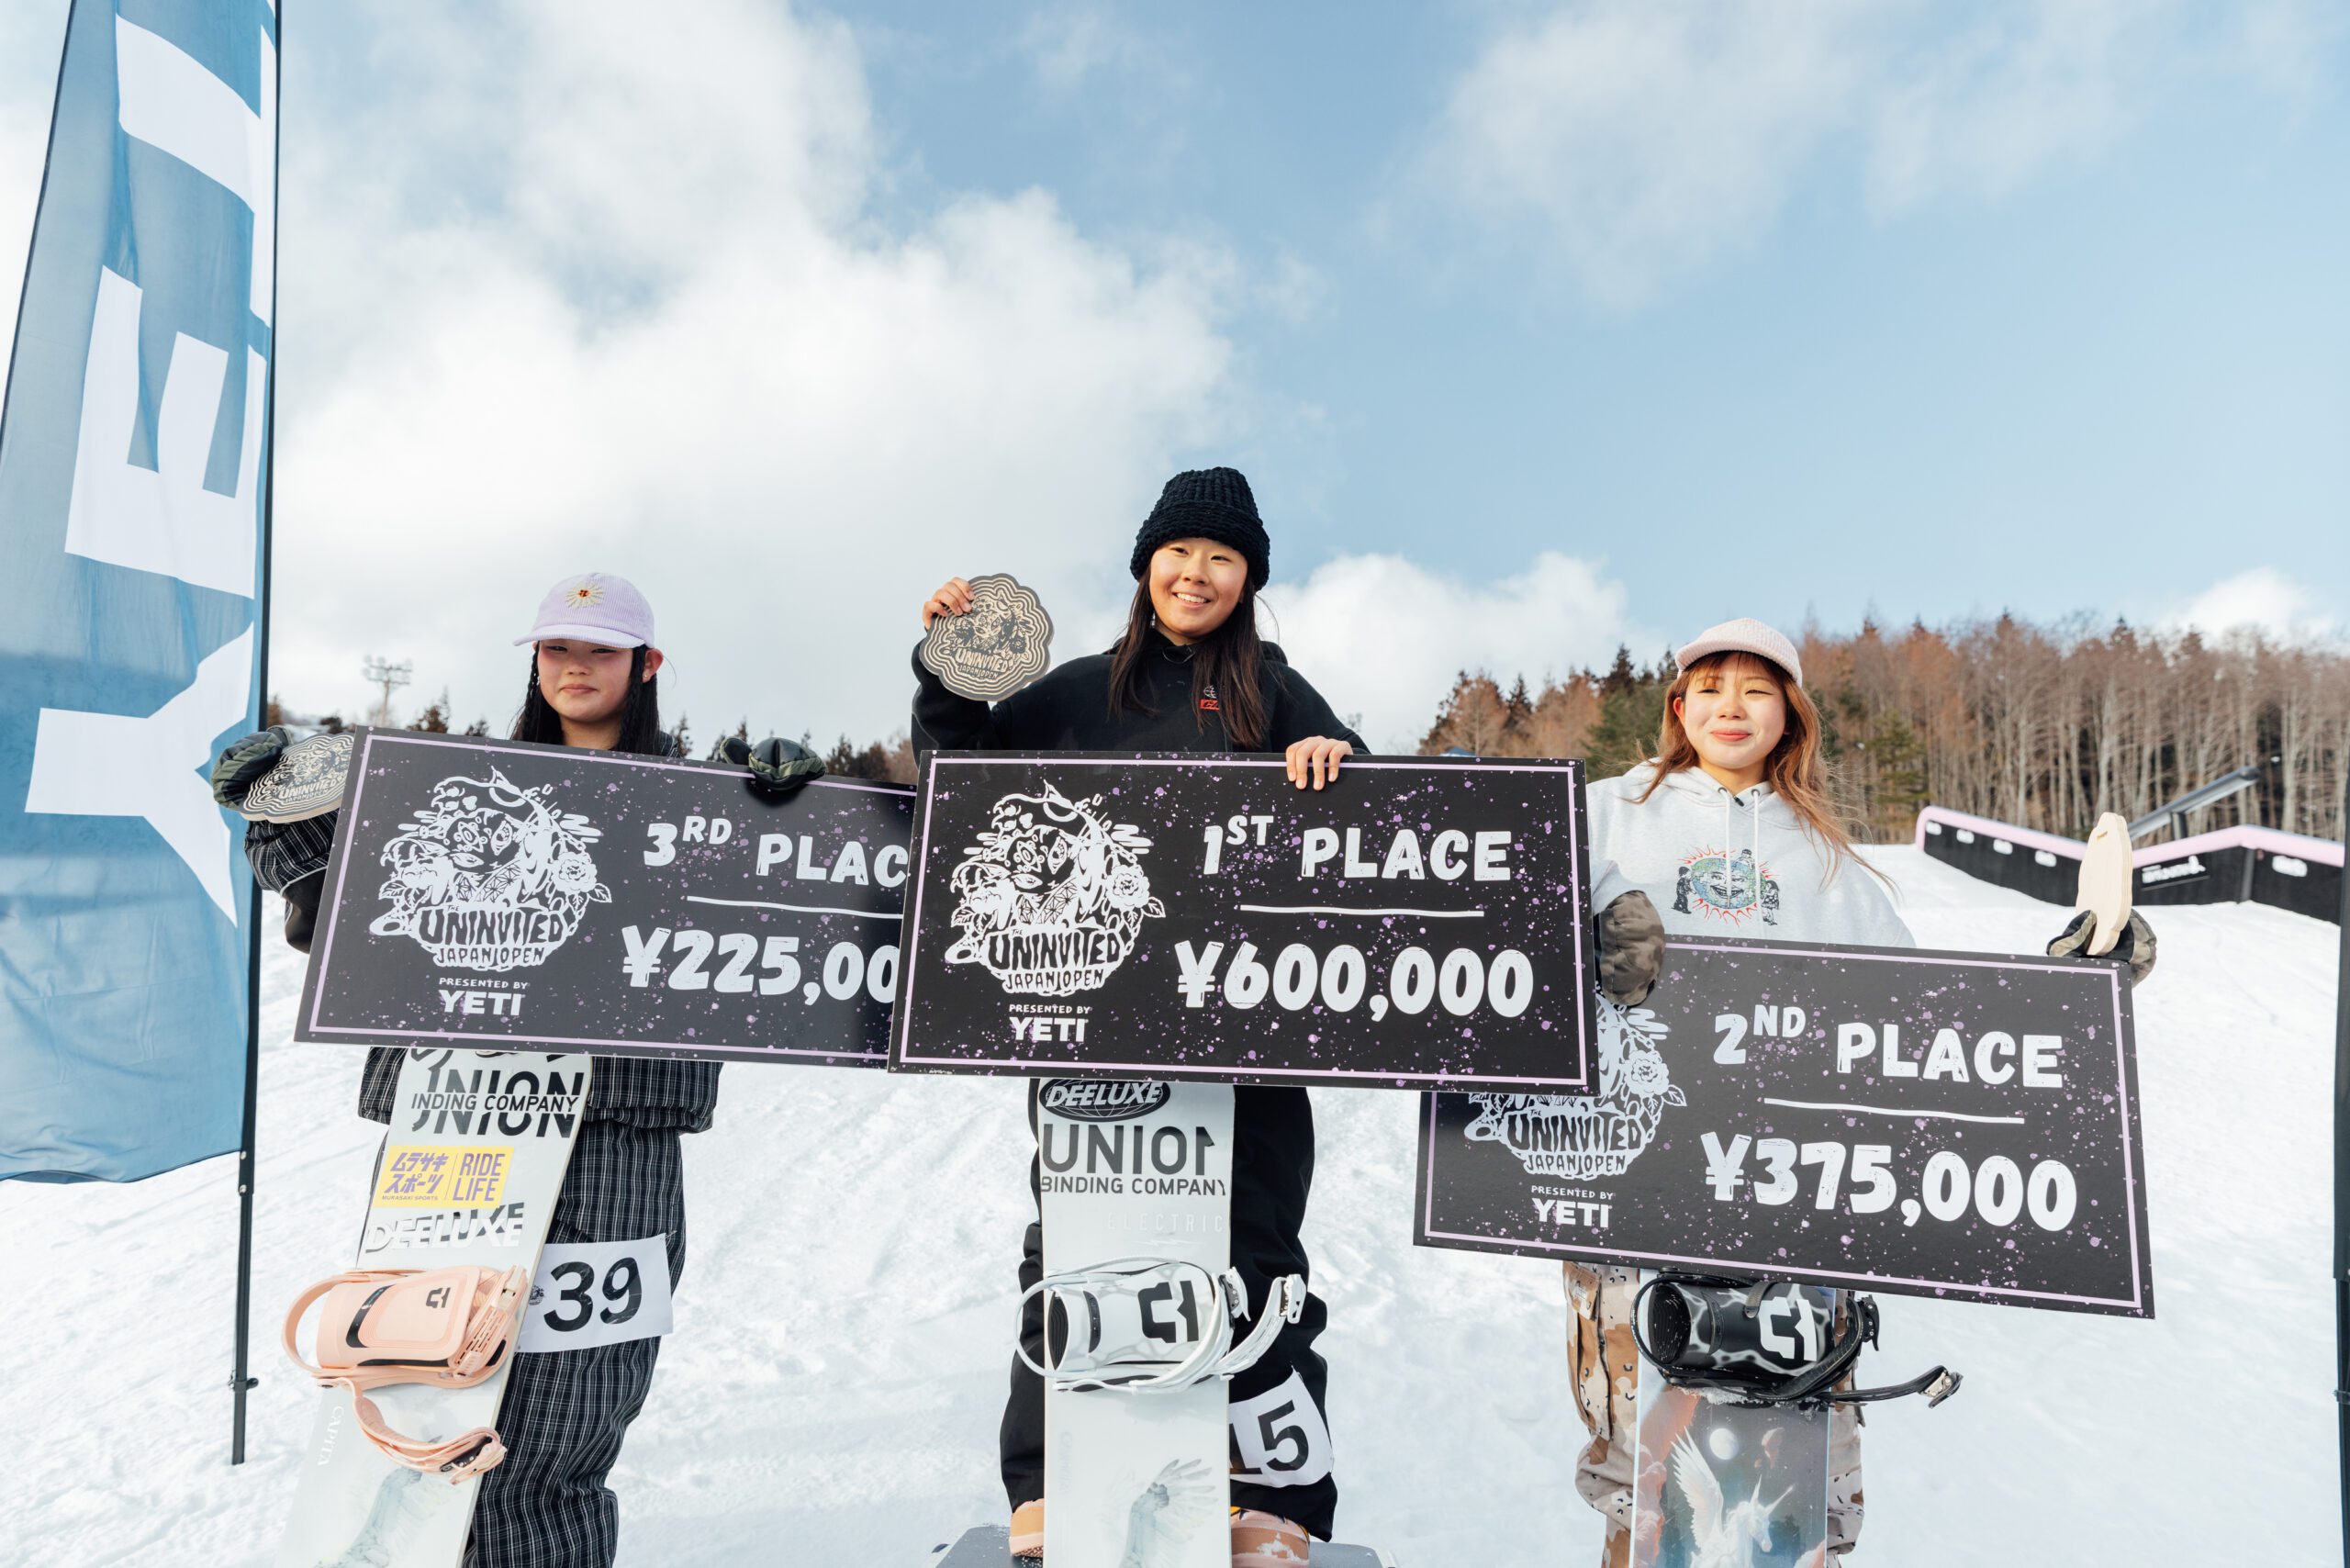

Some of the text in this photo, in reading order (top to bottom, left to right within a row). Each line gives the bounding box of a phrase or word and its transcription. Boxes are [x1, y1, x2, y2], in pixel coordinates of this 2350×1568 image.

[956, 647, 1008, 673] UNINVITED
[278, 778, 337, 800] UNINVITED
[643, 815, 909, 888] 3RD PLAC
[1203, 815, 1512, 881] 1ST PLACE
[419, 906, 564, 946] UNINVITED
[988, 931, 1120, 970] UNINVITED
[621, 924, 901, 1006] ¥225,00
[439, 977, 529, 990] PRESENTED BY
[1174, 939, 1534, 1022] ¥600,000
[439, 990, 524, 1016] YETI
[1009, 1003, 1091, 1014] PRESENTED BY
[1009, 1016, 1086, 1043] YETI
[1713, 1004, 2064, 1088] 2ND PLACE
[411, 1092, 580, 1113] INDING COMPANY
[1046, 1081, 1163, 1107] DEELUXE
[1507, 1113, 1642, 1153] UNINVITED
[390, 1152, 449, 1172] ムラサキ
[459, 1153, 505, 1177] RIDE
[384, 1173, 444, 1194] スポーツ
[453, 1178, 499, 1202] LIFE
[1041, 1176, 1124, 1194] BINDING
[1531, 1185, 1614, 1200] PRESENTED BY
[1700, 1131, 2077, 1232] ¥375,000
[1108, 1212, 1224, 1233] ELECTRIC
[1531, 1197, 1609, 1228] YETI
[365, 1202, 524, 1253] DEELUXE
[543, 1257, 643, 1332] 39
